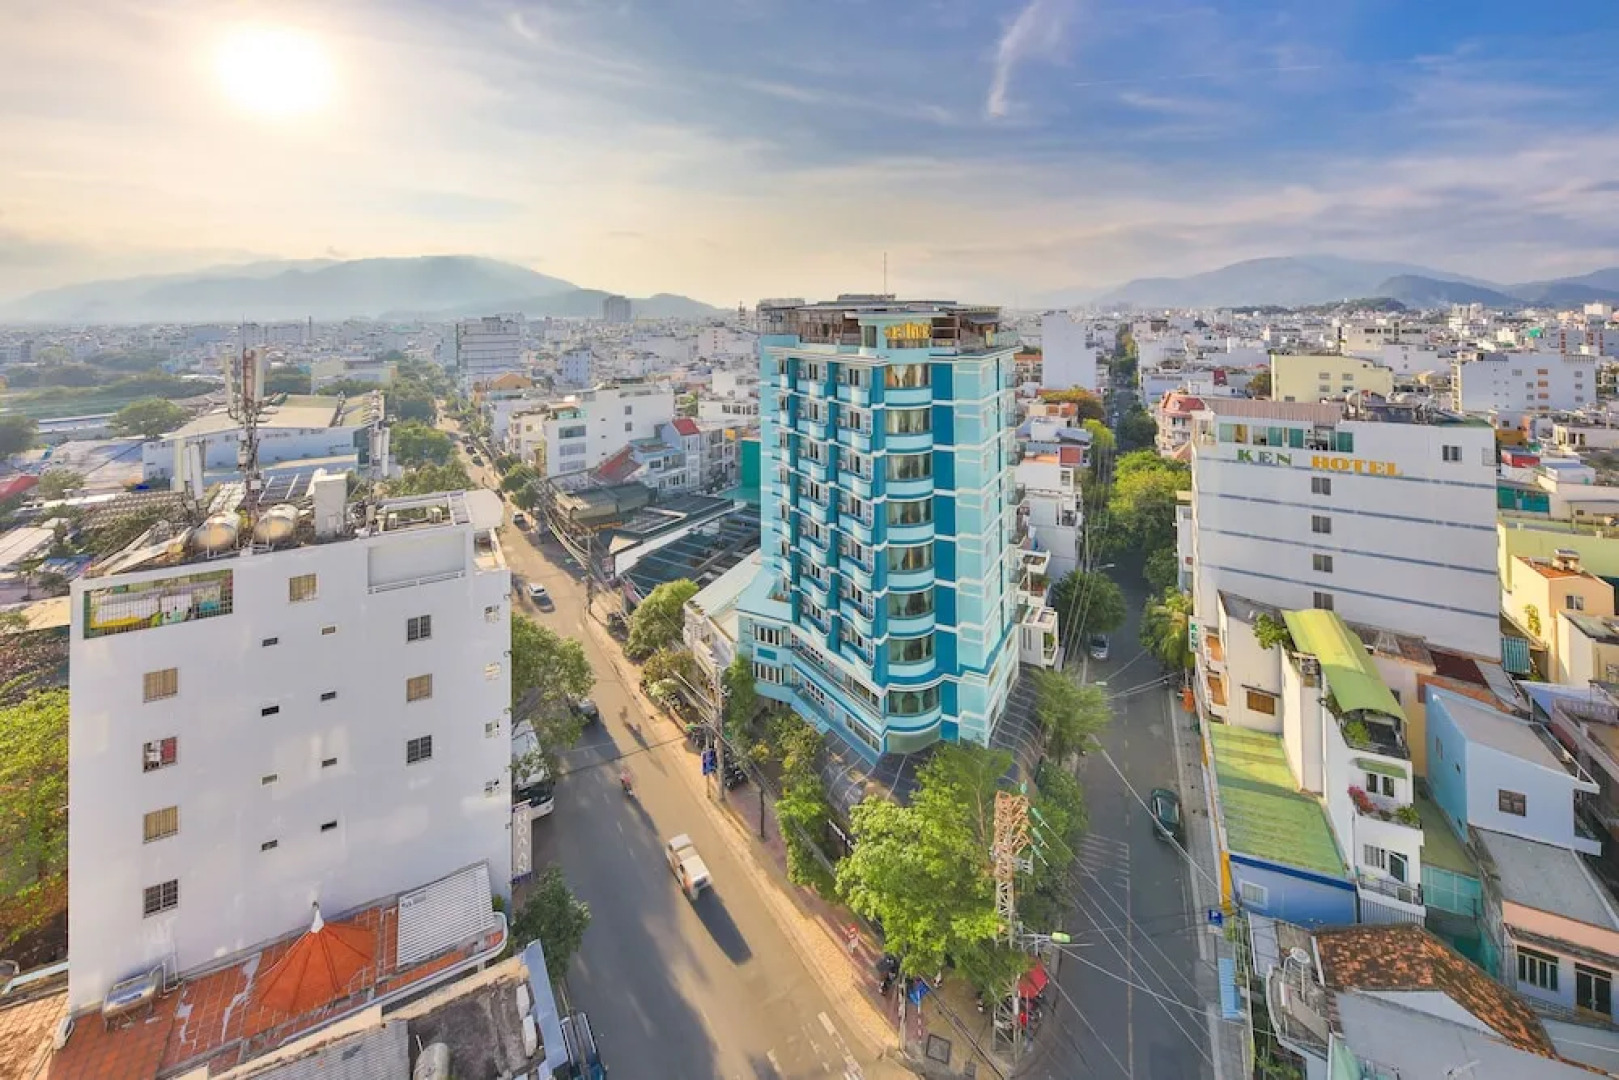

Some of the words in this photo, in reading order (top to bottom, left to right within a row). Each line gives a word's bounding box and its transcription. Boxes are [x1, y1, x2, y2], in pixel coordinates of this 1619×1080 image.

[1236, 449, 1292, 467] KEN
[1311, 454, 1403, 476] HOTEL
[1190, 622, 1199, 649] KEN
